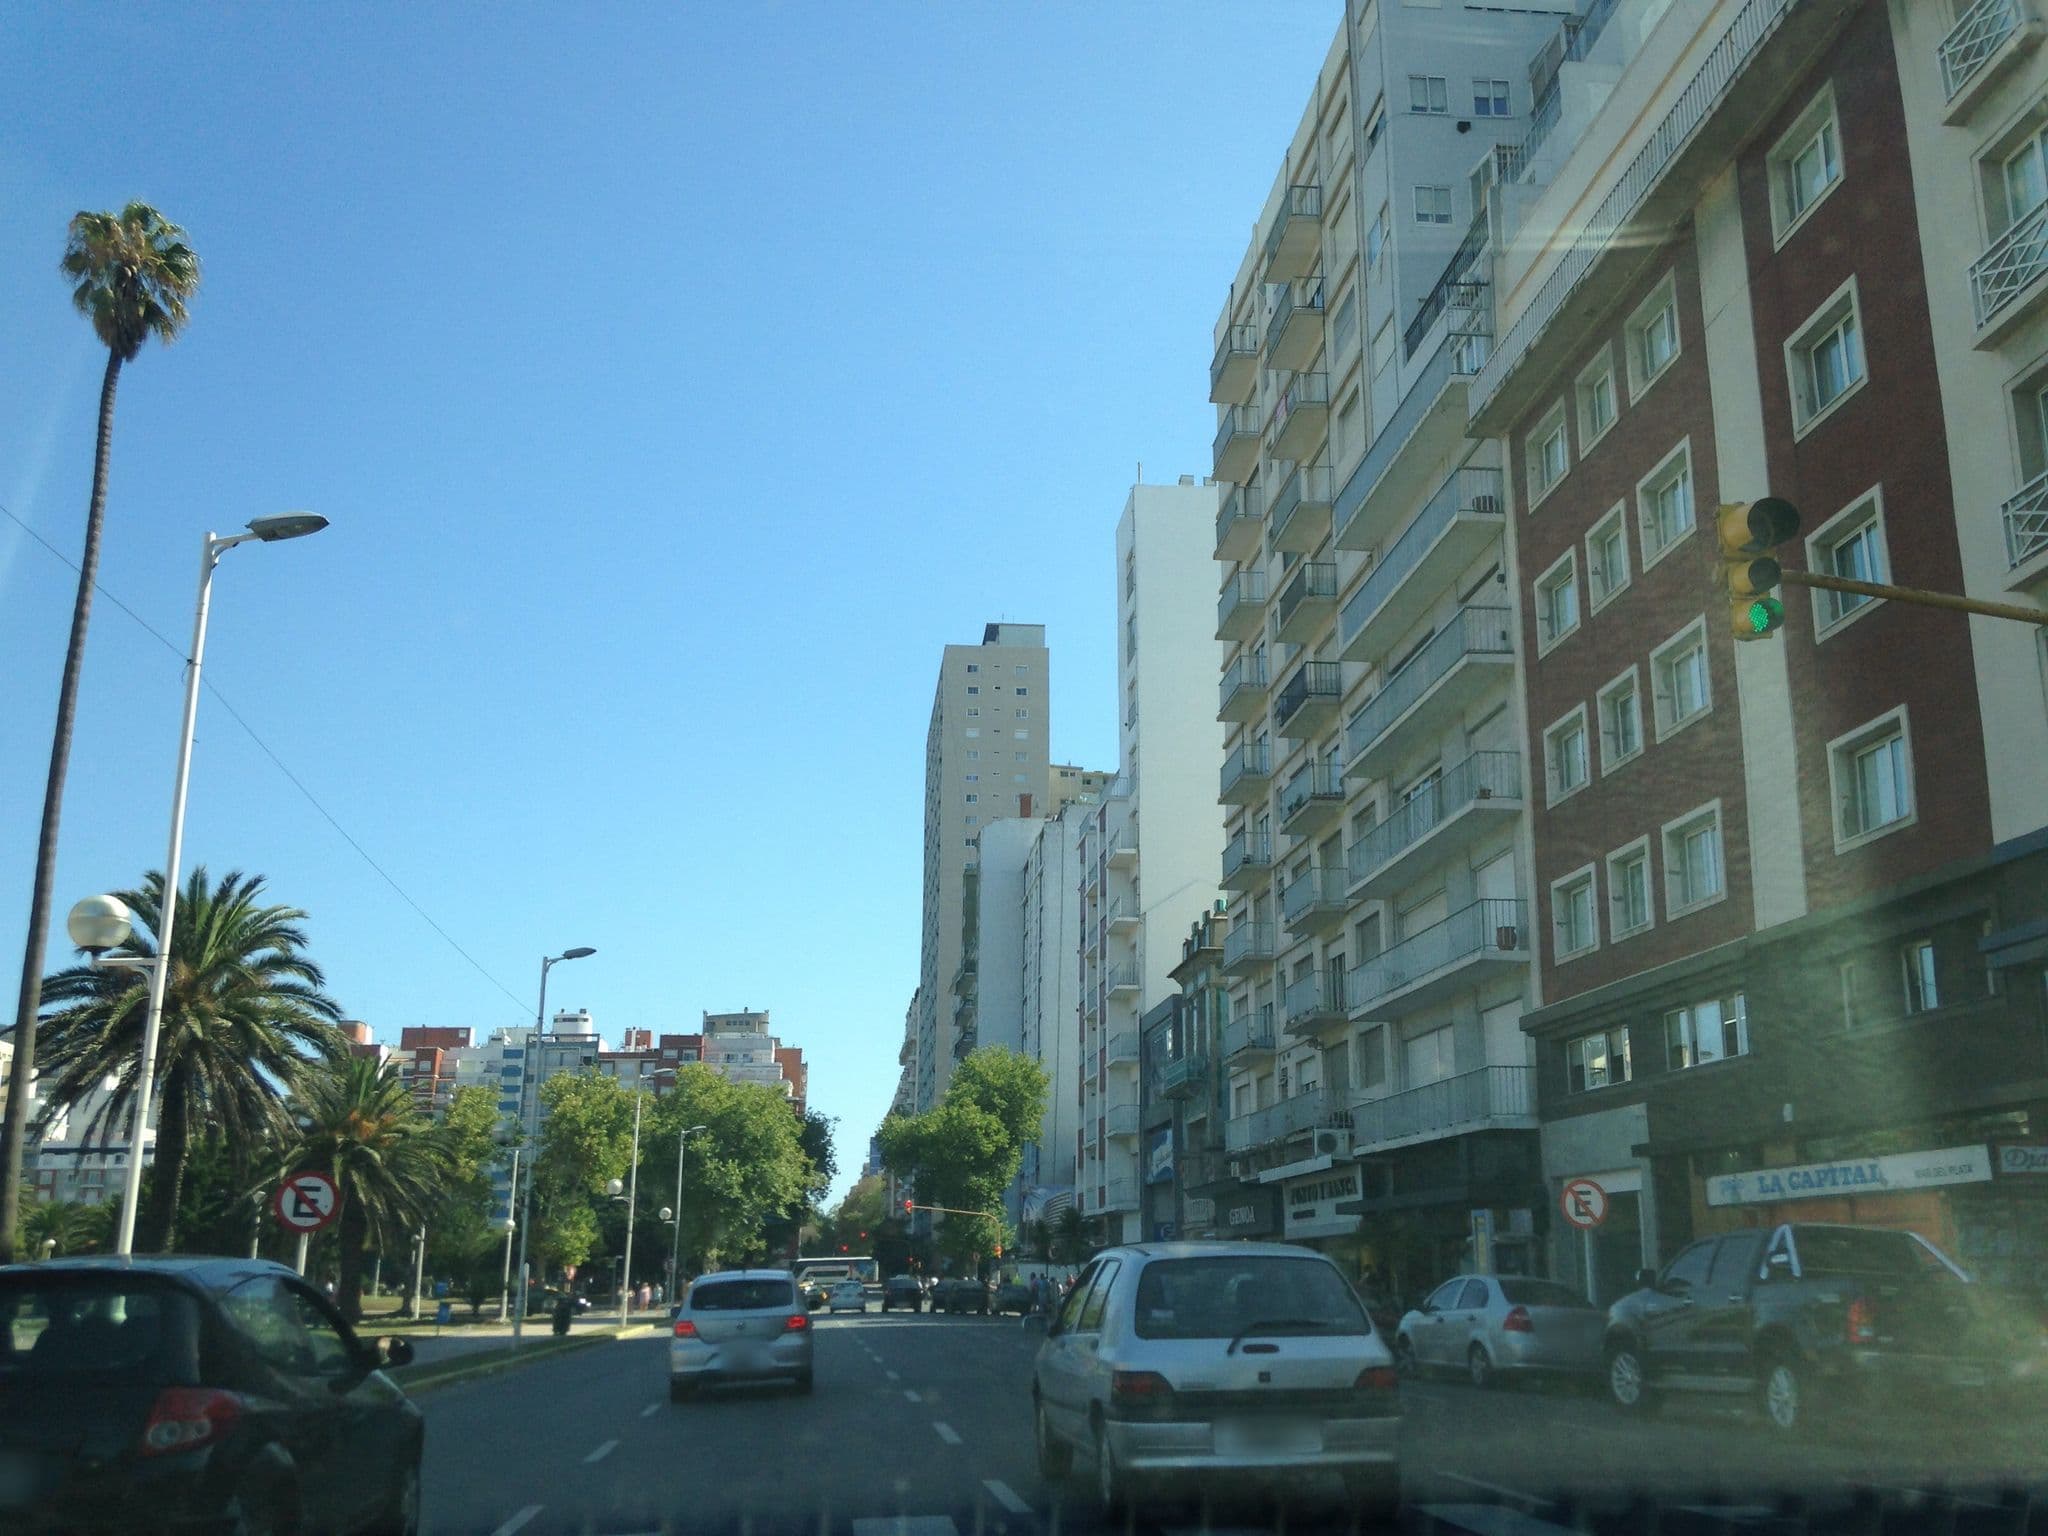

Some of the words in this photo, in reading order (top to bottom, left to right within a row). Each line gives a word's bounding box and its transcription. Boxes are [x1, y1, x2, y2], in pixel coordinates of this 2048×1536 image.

[1757, 1175, 1783, 1194] LA
[1788, 1163, 1881, 1191] CAPITAL
[293, 1186, 321, 1217] E
[1575, 1191, 1591, 1216] E
